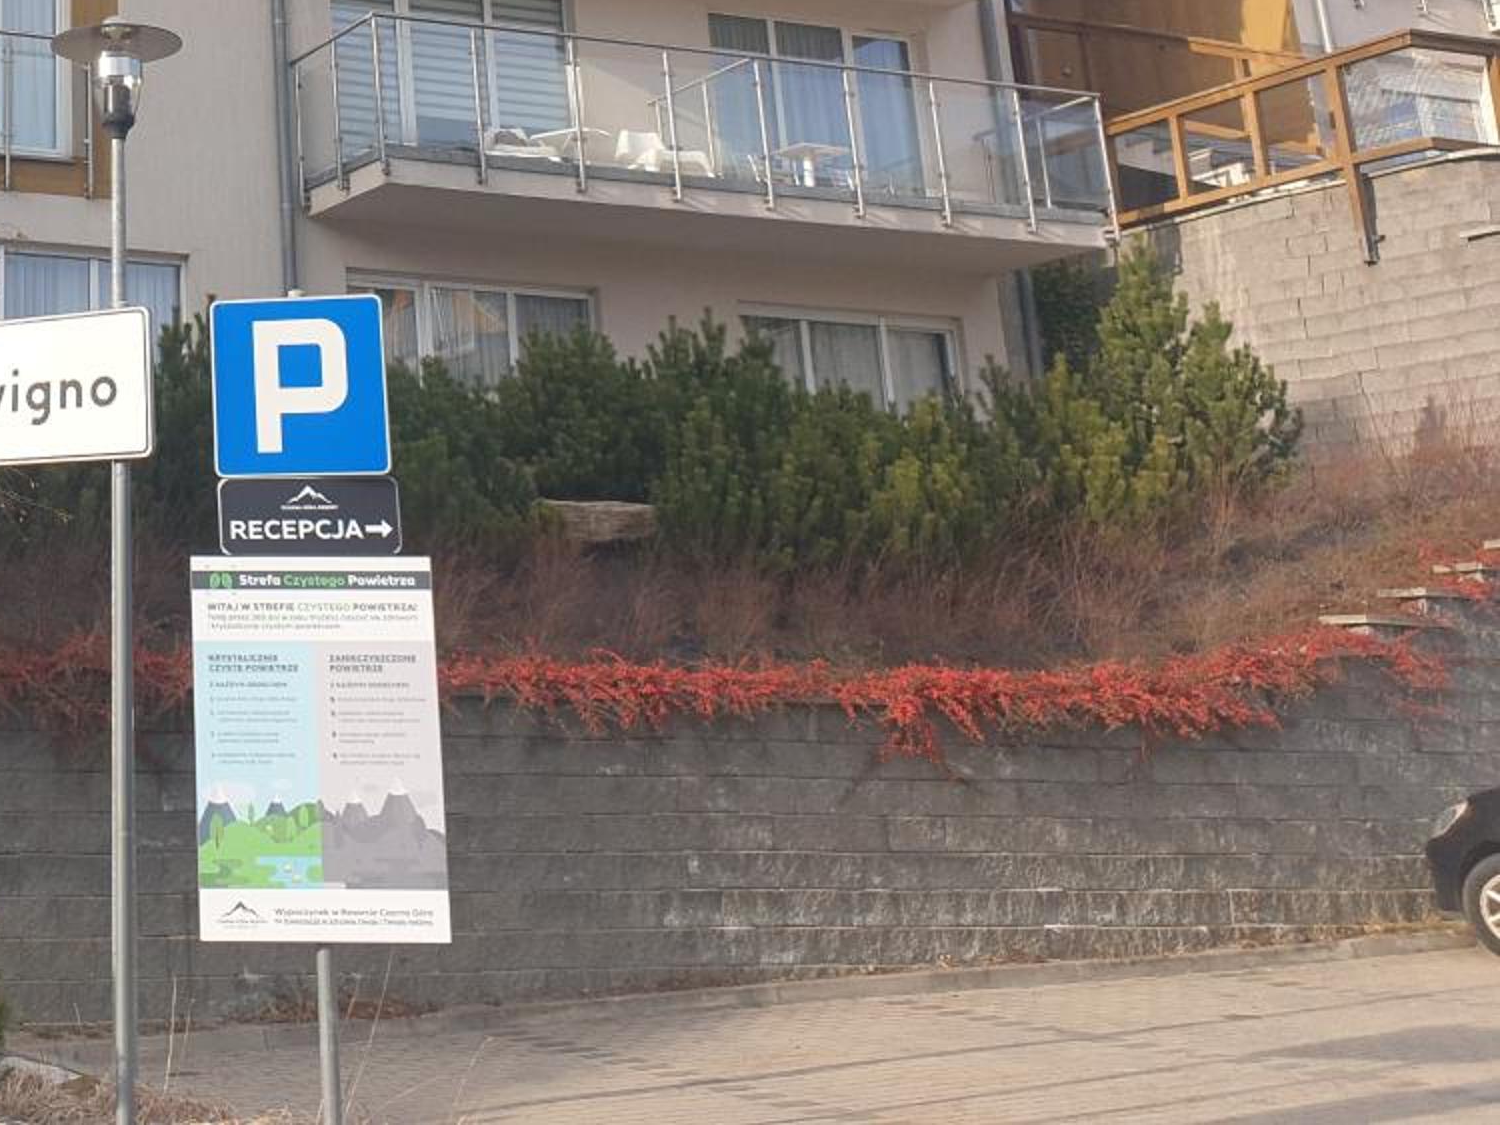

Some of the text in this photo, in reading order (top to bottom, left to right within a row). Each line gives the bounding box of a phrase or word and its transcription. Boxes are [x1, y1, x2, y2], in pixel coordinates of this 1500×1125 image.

[252, 318, 349, 454] P
[230, 519, 364, 540] RECEPCJA
[238, 574, 416, 588] Strefa Czystego Powietrza
[207, 603, 239, 612] WITAJ
[241, 603, 251, 612] W
[253, 603, 295, 612] STREFIE
[297, 602, 351, 612] CZYSTEGO
